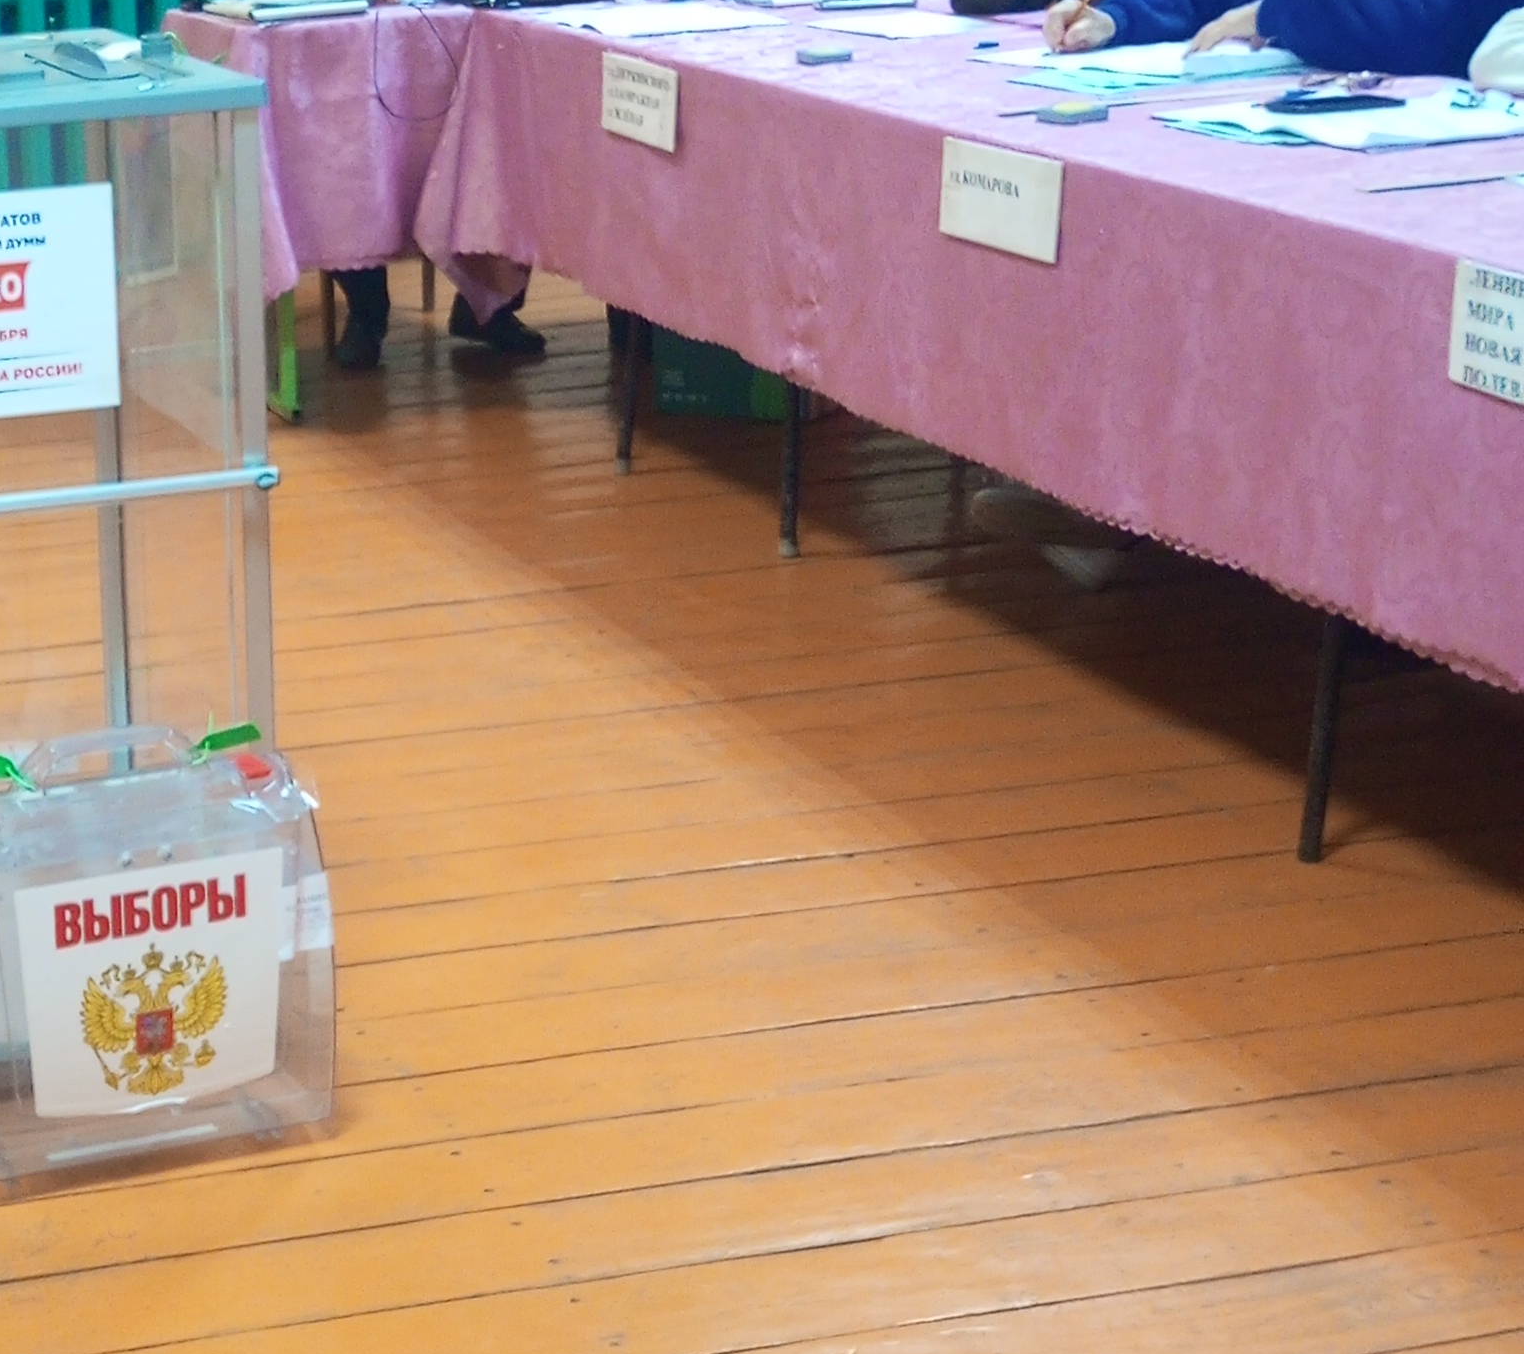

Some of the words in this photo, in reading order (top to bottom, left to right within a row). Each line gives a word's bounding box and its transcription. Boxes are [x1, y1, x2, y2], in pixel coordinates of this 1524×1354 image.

[6, 236, 46, 250] ДУМЫ
[1464, 331, 1522, 366] НОВАЯ
[14, 362, 83, 381] РОССИИ!
[1463, 364, 1524, 398] ПОЛЕВ
[53, 873, 247, 950] ВЫБОРЫ
